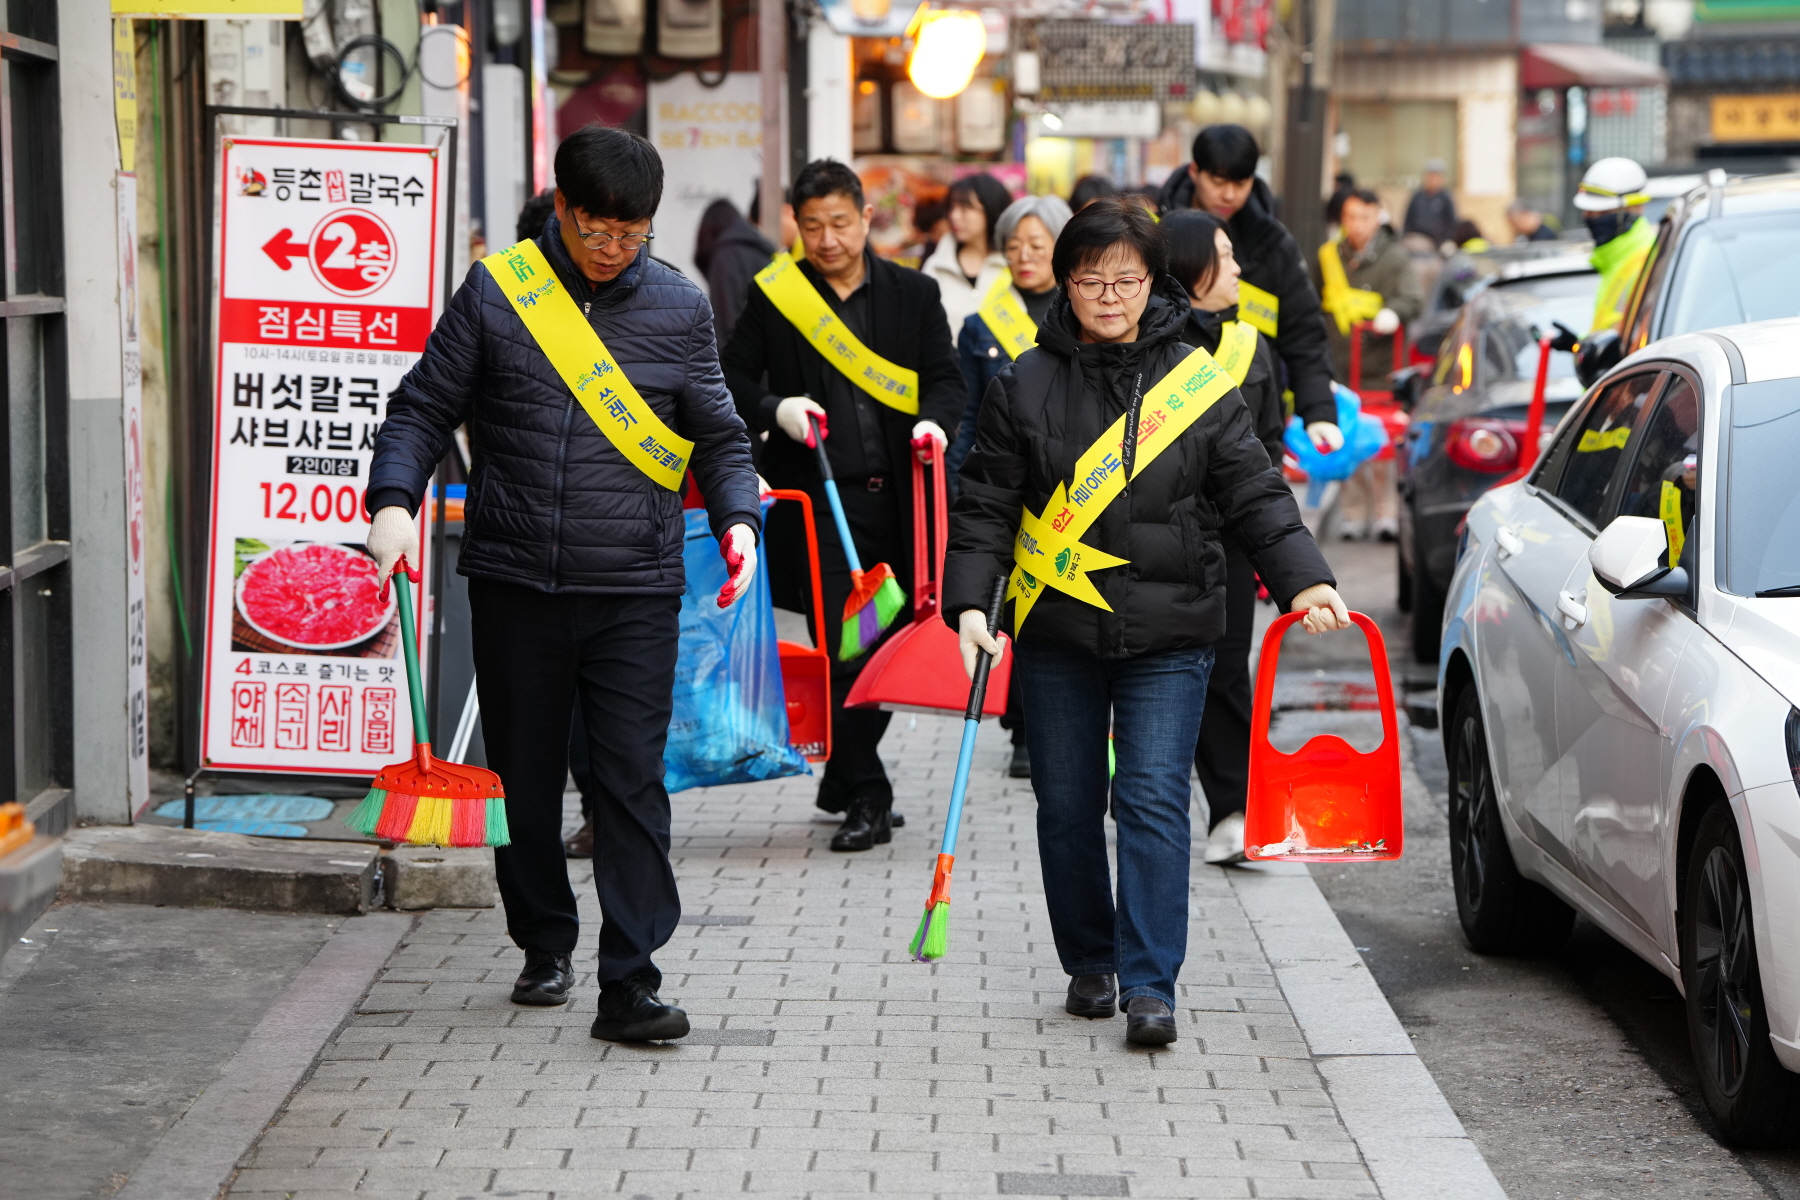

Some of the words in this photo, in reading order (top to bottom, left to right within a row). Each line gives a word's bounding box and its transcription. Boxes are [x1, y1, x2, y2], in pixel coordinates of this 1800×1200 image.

[321, 221, 391, 282] 2층
[258, 306, 398, 345] 점심특선
[344, 351, 377, 365] 공휴일
[381, 353, 408, 367] 제외)
[599, 387, 638, 431] 쓰레기
[1165, 393, 1184, 411] 앞
[291, 457, 354, 476] 2인이상
[1070, 452, 1122, 507] 내손으로
[1066, 552, 1081, 580] 강북구
[1017, 576, 1031, 599] 강북구
[317, 663, 370, 682] 즐기는
[378, 666, 395, 684] 맛
[235, 686, 263, 744] 야채
[279, 685, 305, 746] 소고기
[320, 690, 350, 747] 사리
[367, 692, 391, 750] 볶음밥
